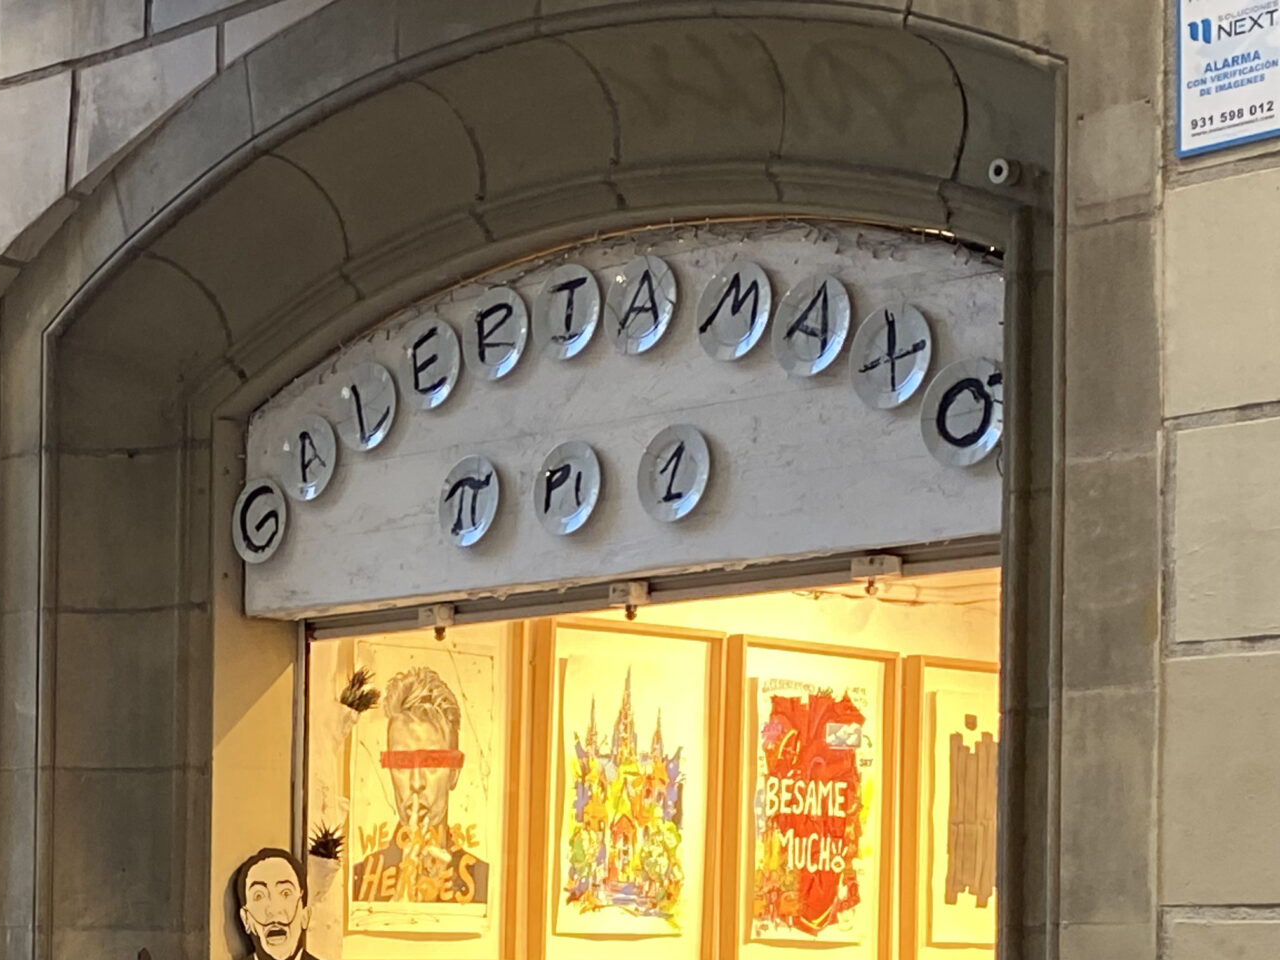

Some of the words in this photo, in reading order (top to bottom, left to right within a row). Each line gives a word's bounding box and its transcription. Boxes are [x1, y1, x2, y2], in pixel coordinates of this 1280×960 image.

[1217, 9, 1279, 40] NEXT
[1204, 50, 1261, 73] ALARMA
[1187, 76, 1207, 89] CON
[1200, 86, 1211, 97] DE
[1191, 115, 1213, 130] 931
[1220, 108, 1244, 123] 598
[1249, 100, 1274, 116] 012
[661, 441, 685, 505] 1
[765, 769, 848, 817] BÉSAME
[358, 821, 391, 855] WE
[449, 822, 480, 852] BE
[778, 828, 849, 873] MUCHO
